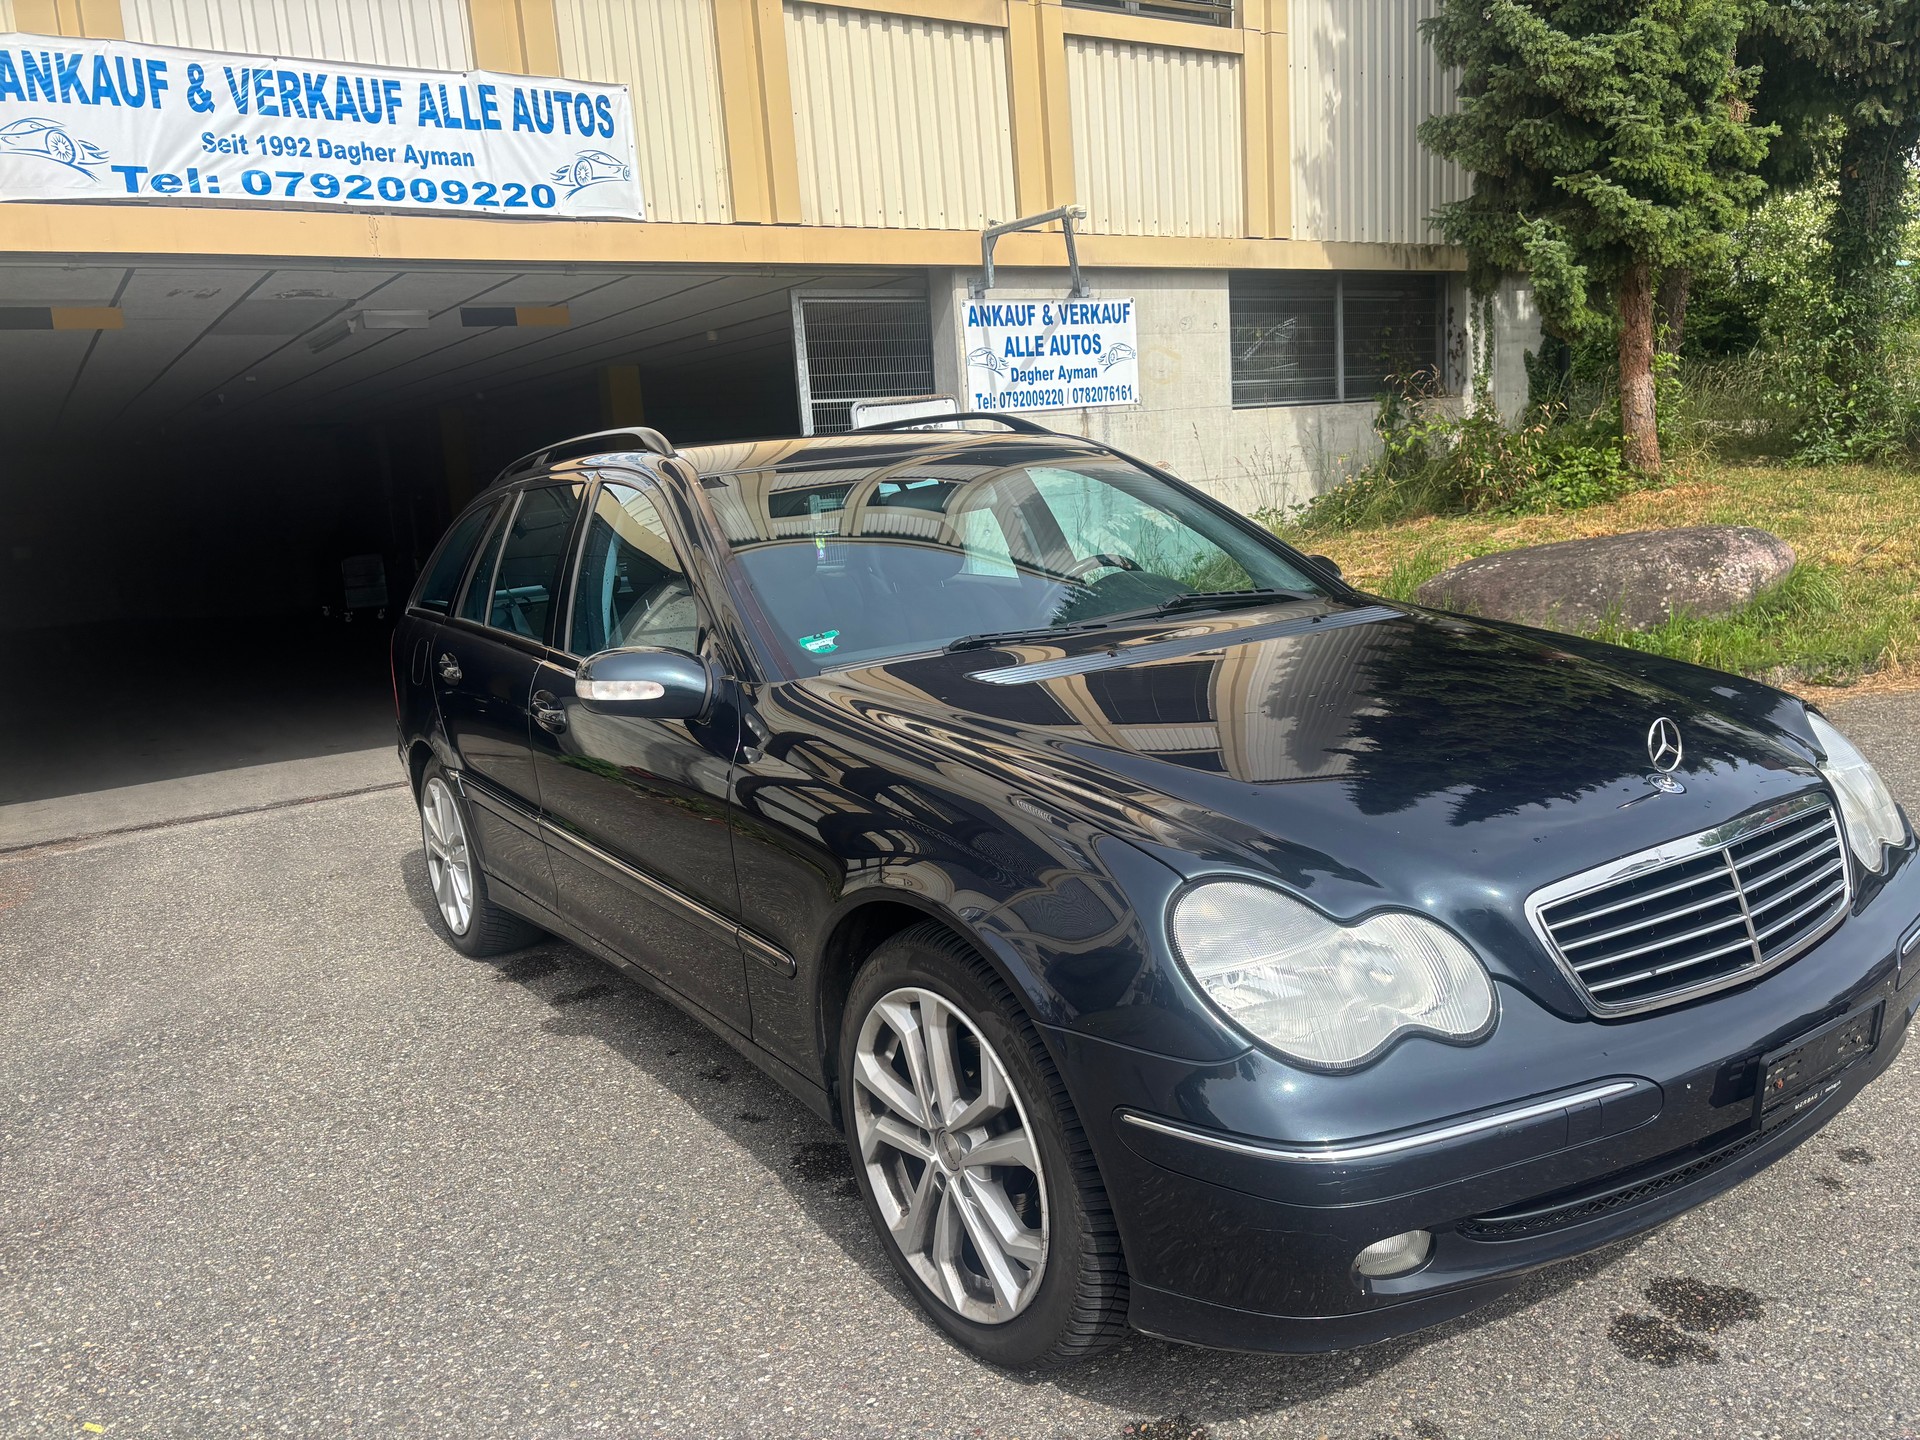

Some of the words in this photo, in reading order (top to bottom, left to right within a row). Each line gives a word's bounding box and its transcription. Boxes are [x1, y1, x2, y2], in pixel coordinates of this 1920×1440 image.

[0, 50, 169, 110] ANKAUF
[187, 63, 216, 114] &
[223, 67, 403, 125] VERKAUF
[417, 83, 502, 131] ALLE
[513, 88, 615, 139] AUTOS
[202, 132, 248, 155] Seit
[256, 135, 313, 158] 1992
[317, 139, 396, 167] Dagher
[404, 144, 475, 170] Ayman
[111, 165, 220, 194] Tel:
[241, 170, 557, 209] 0792009220
[968, 305, 1036, 327] ANKAUF
[1042, 304, 1054, 326] &
[1058, 303, 1131, 325] VERKAUF
[1004, 335, 1045, 358] ALLE
[1050, 333, 1102, 356] AUTOS
[1011, 366, 1055, 386] Dagher
[1058, 365, 1098, 384] Ayman
[975, 393, 997, 410] Tel:
[1000, 388, 1063, 409] 0792009220
[1072, 384, 1133, 404] 0782076161
